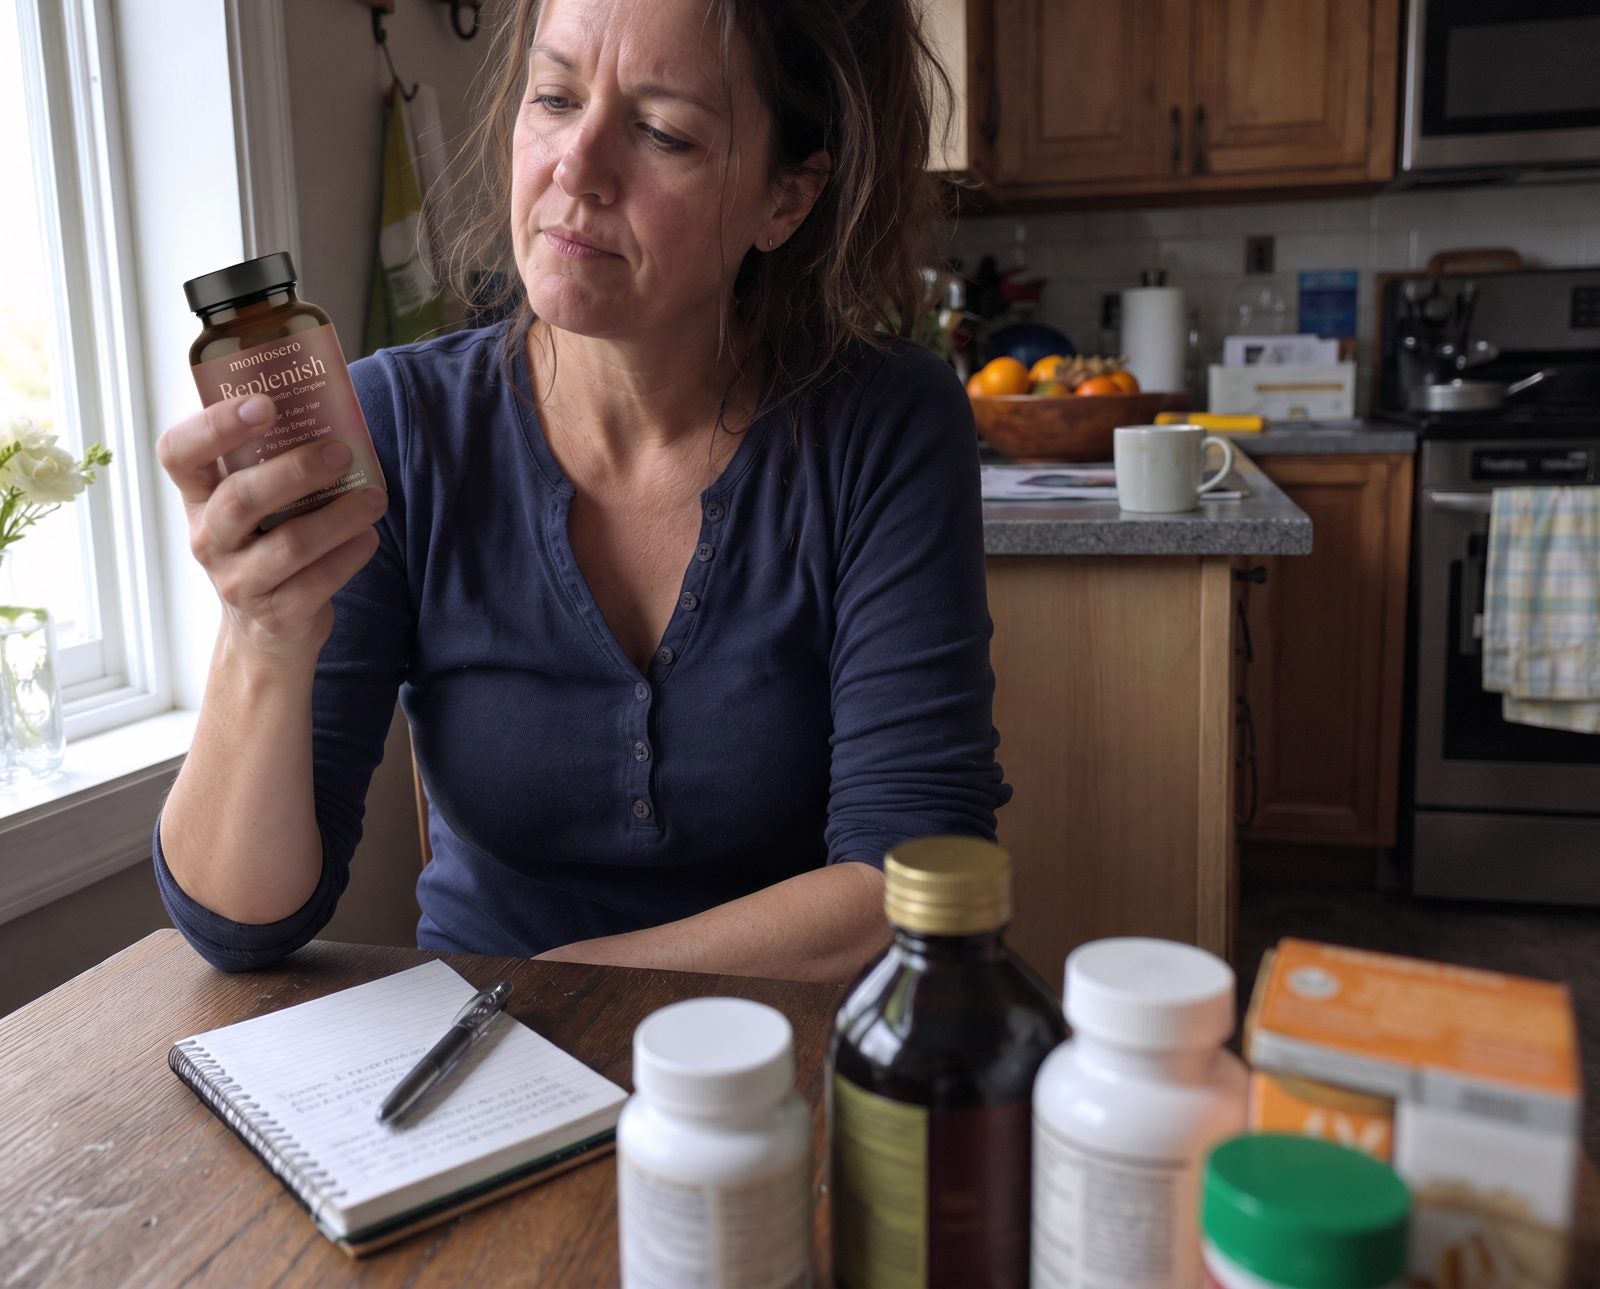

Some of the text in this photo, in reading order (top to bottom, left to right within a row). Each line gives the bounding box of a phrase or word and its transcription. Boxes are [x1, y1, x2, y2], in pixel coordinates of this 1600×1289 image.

[229, 342, 301, 372] montosero
[219, 356, 327, 400] Replenish
[293, 380, 327, 396] Complex
[290, 417, 316, 430] Energy
[266, 442, 278, 450] No
[279, 433, 311, 448] Stomach
